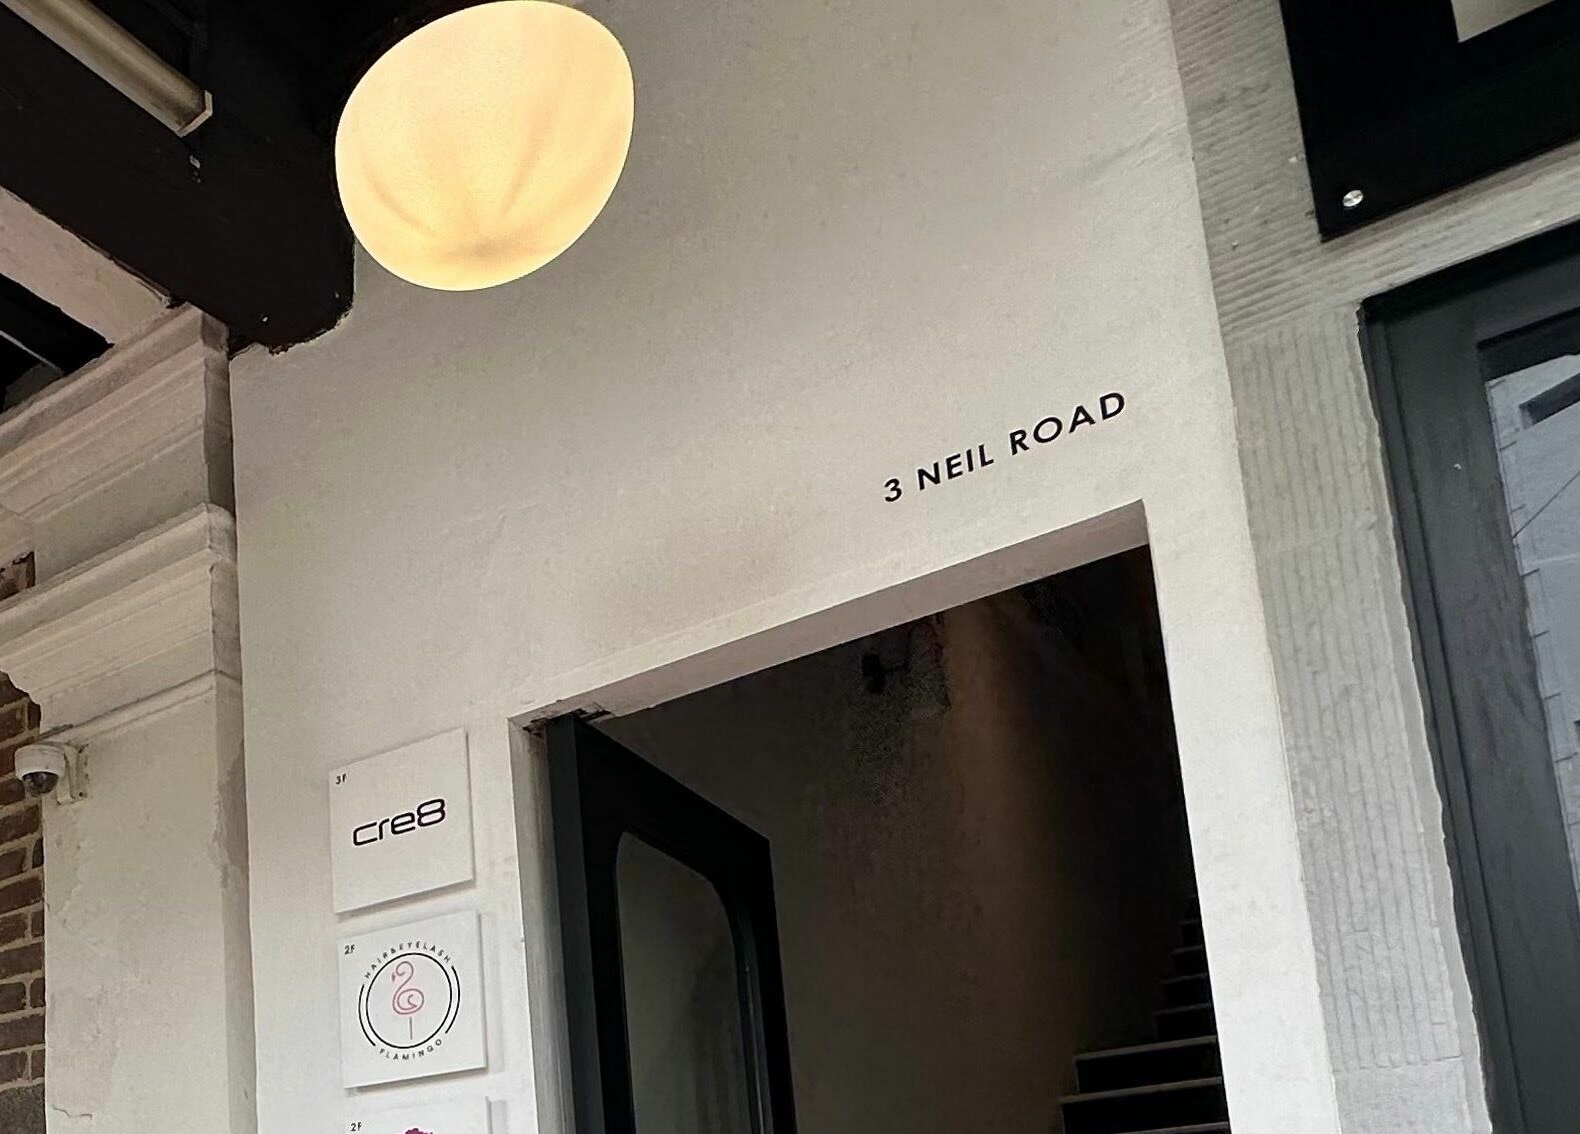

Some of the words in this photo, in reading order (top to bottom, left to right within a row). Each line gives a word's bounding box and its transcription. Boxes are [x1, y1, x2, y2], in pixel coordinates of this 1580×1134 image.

[884, 478, 902, 502] 3
[917, 444, 994, 490] NEIL
[1009, 392, 1125, 455] ROAD
[353, 798, 446, 846] cre8
[344, 944, 355, 955] 2F
[364, 941, 452, 979] HAIR&EYELASH
[379, 1038, 442, 1061] FLAMINGO
[350, 1121, 362, 1132] 2F
